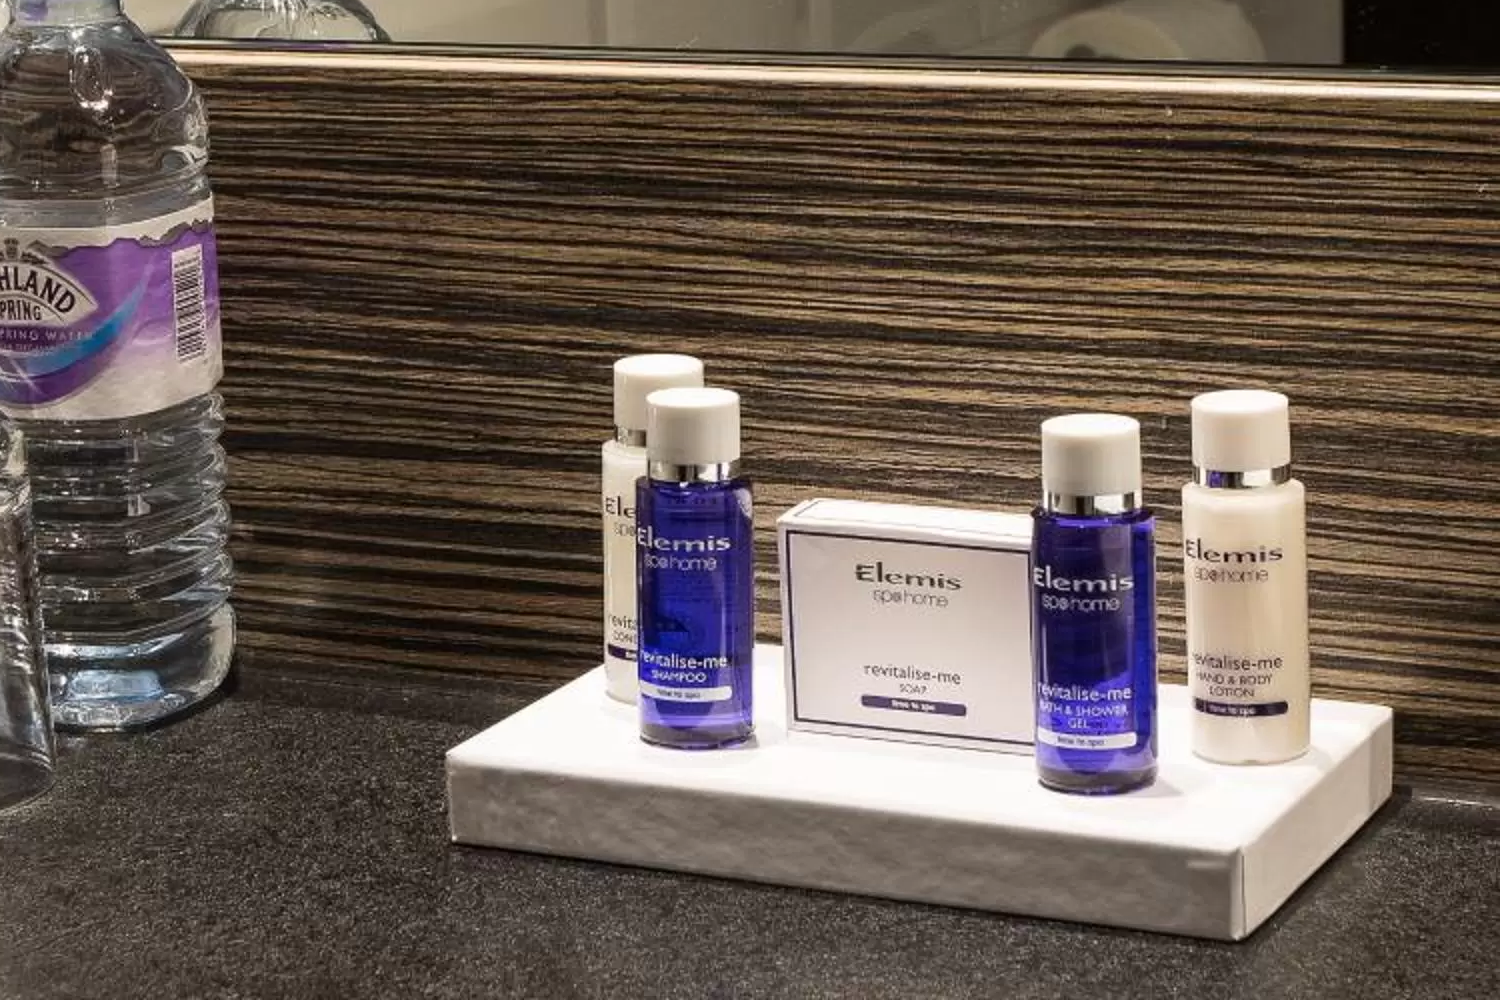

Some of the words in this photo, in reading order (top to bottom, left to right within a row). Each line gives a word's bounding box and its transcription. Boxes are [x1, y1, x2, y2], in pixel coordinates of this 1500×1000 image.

[605, 495, 636, 518] Ele
[637, 525, 732, 553] Elemis
[1185, 537, 1284, 564] Elemis
[855, 561, 963, 591] Elemis
[1033, 565, 1134, 593] Elemis
[651, 669, 708, 683] SHAMPOO
[863, 663, 961, 684] revitalise-me
[1239, 673, 1272, 685] BODY
[1209, 685, 1256, 698] LOTION
[1075, 704, 1129, 717] SHOWER
[1067, 717, 1089, 729] GEL
